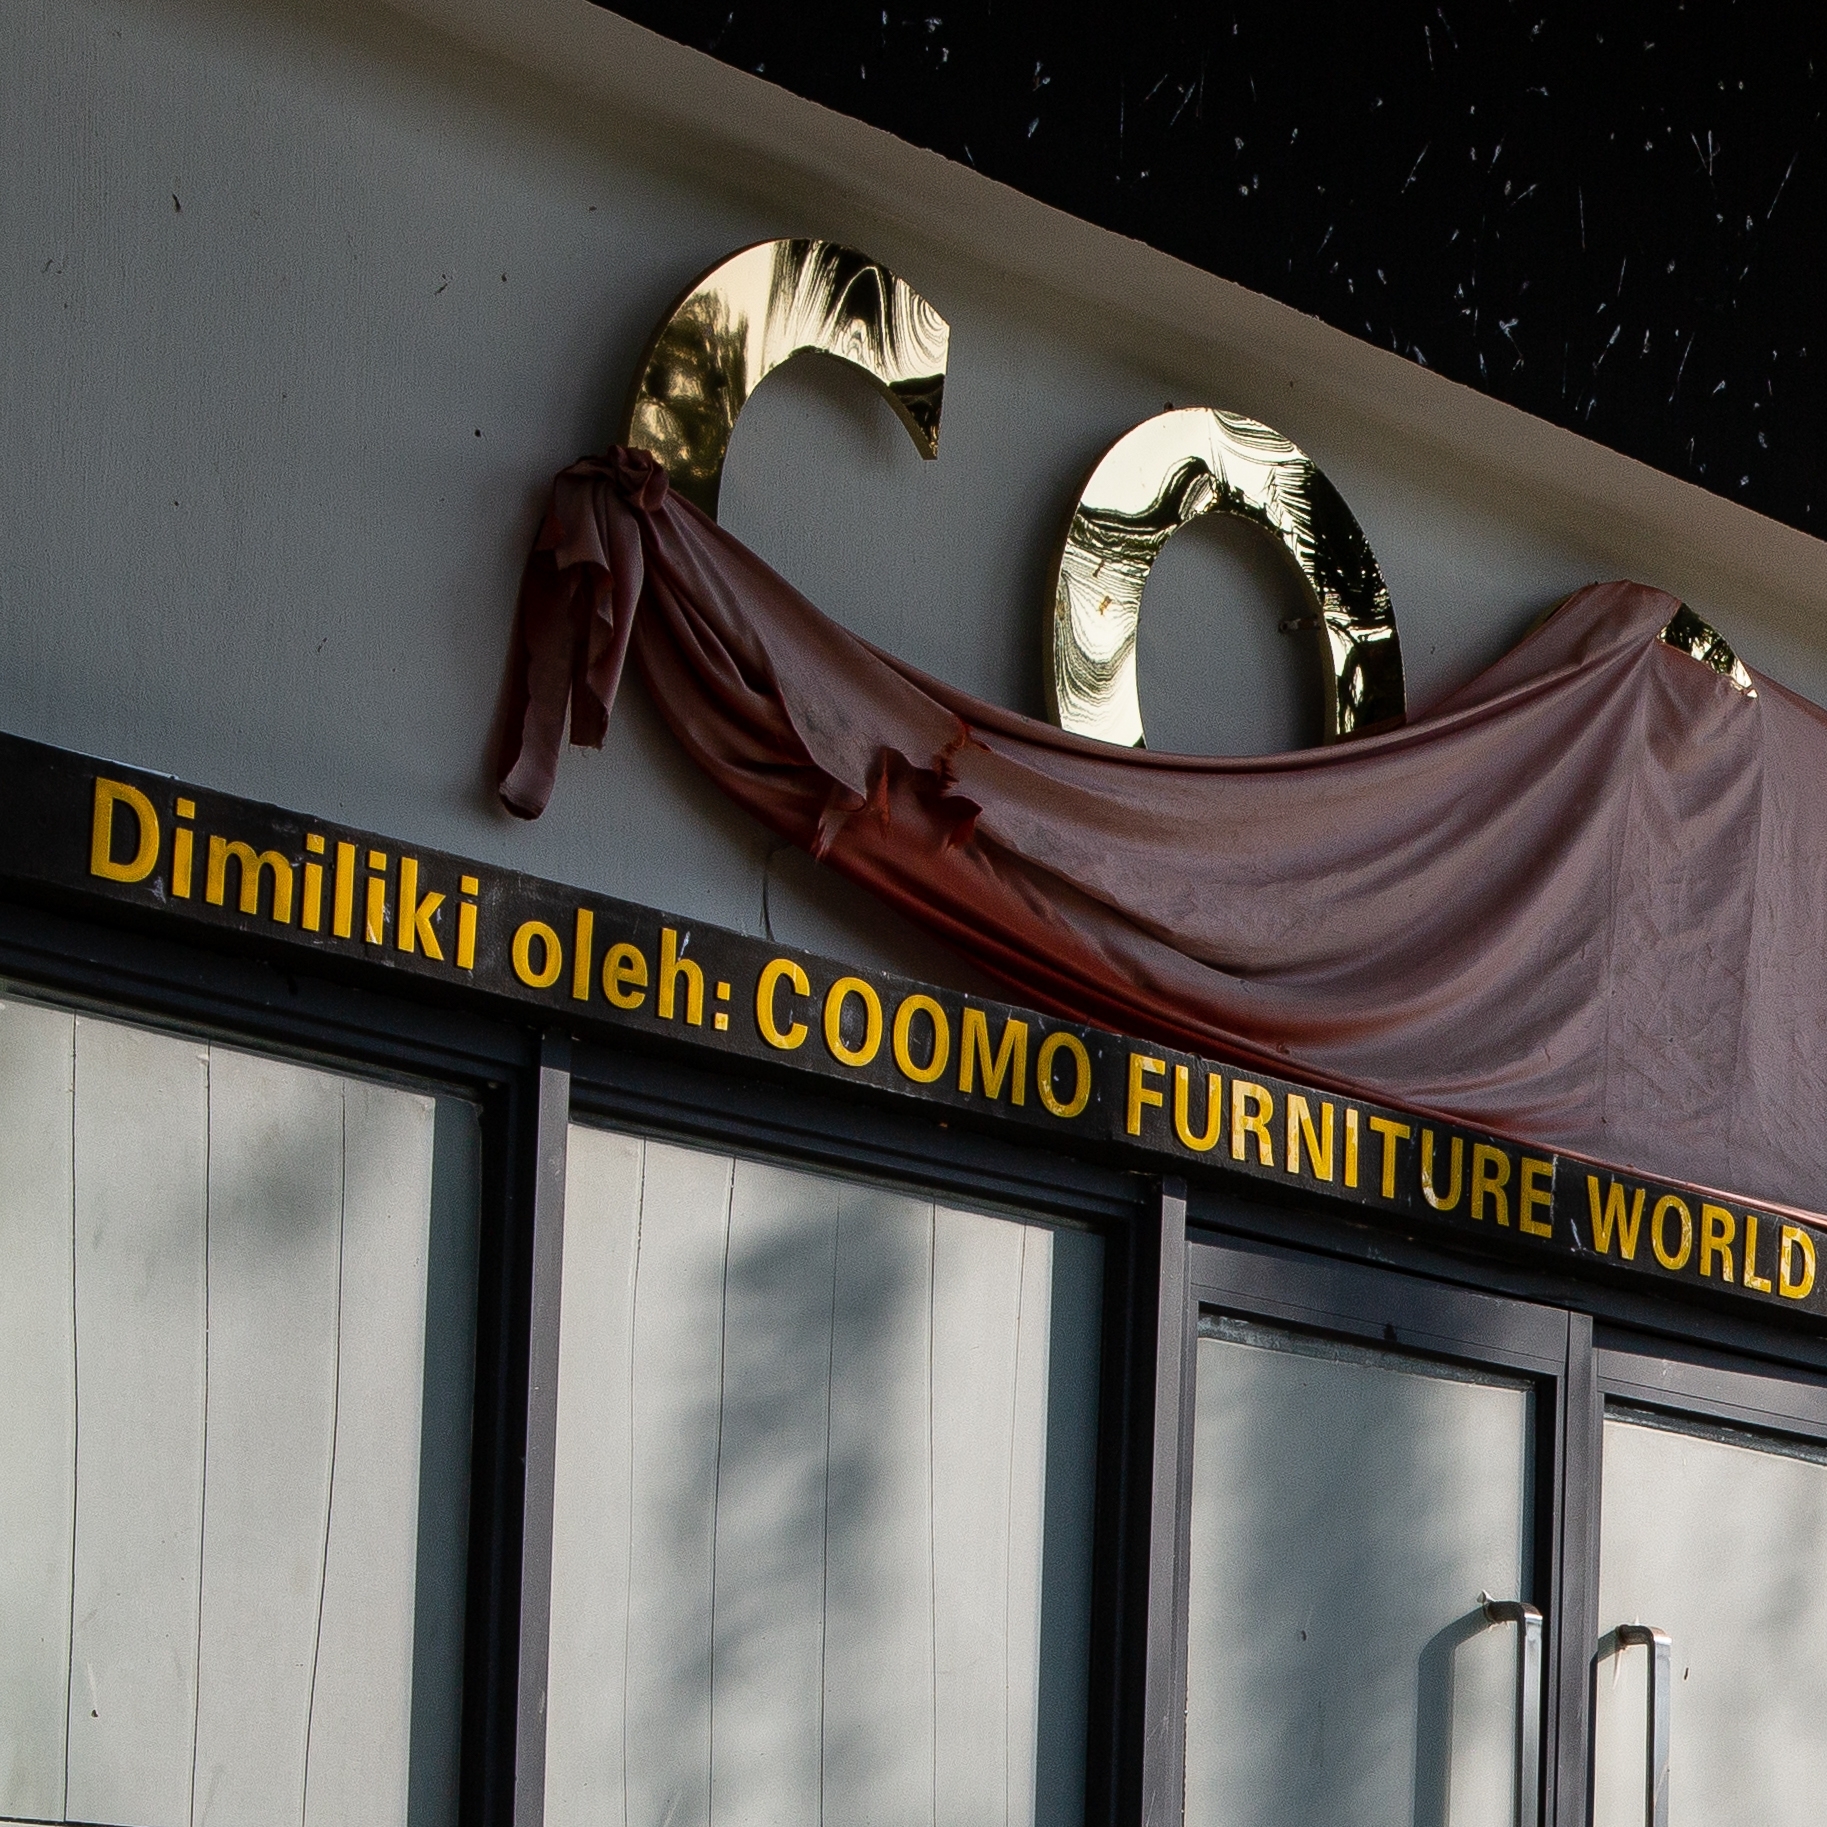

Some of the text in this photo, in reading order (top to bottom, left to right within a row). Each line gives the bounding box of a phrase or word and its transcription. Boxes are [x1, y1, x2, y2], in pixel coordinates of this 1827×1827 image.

[91, 776, 480, 970] Dimiliki
[511, 907, 731, 1031] oleh:
[756, 957, 1092, 1118] COOMO
[1126, 1051, 1554, 1239] FURNITURE
[1586, 1174, 1818, 1302] WORLD
